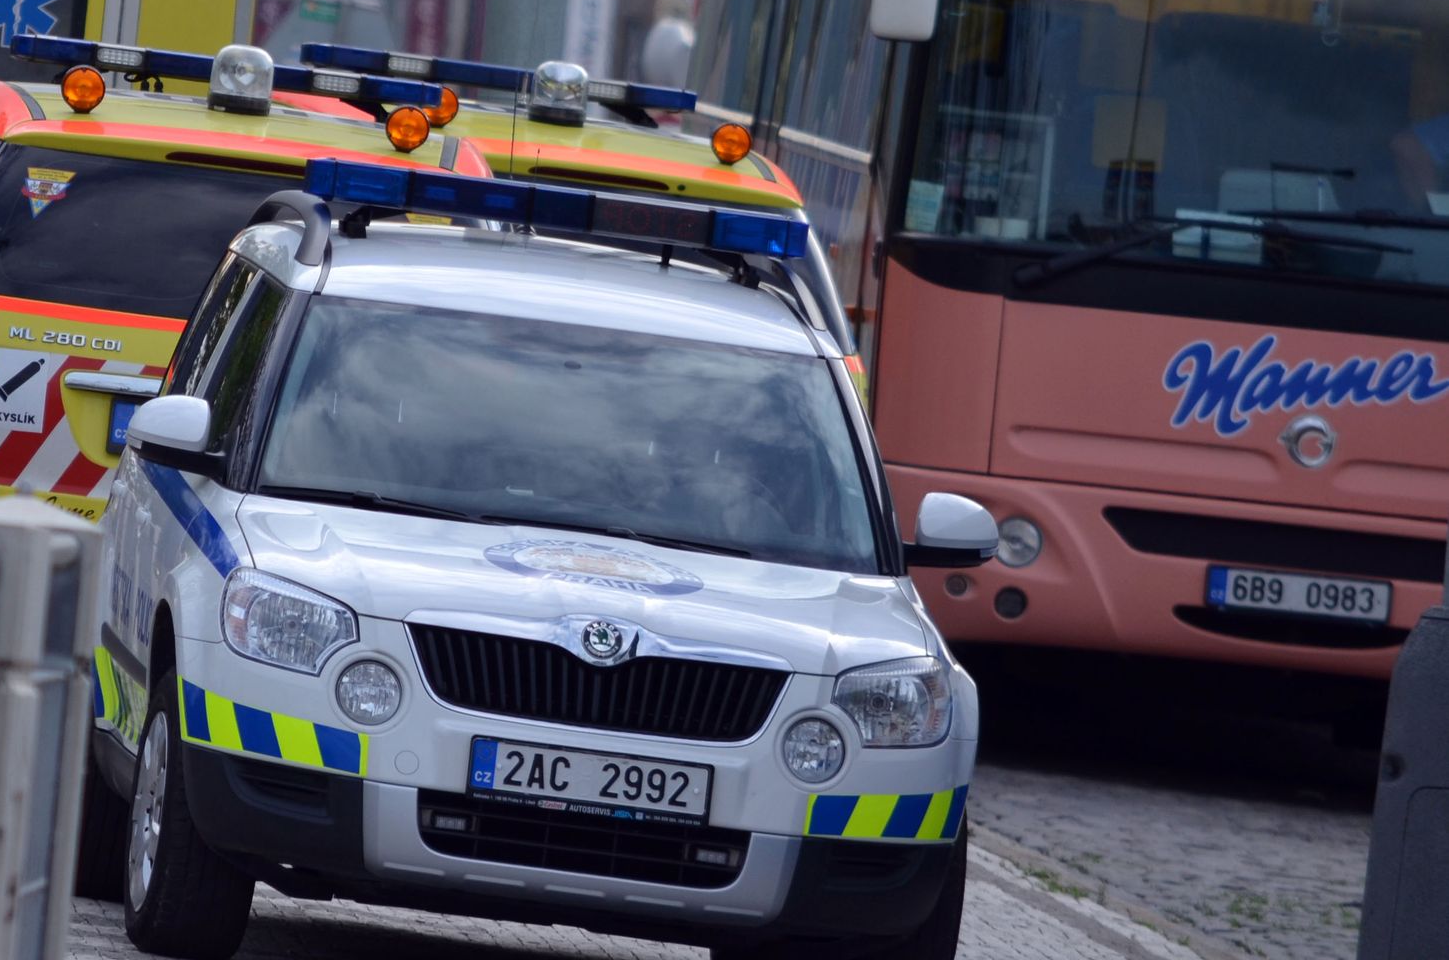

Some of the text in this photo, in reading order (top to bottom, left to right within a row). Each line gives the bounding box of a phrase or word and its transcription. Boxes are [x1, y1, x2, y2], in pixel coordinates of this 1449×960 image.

[9, 326, 122, 352] ML 280 CDI
[1162, 333, 1449, 437] Manner
[1233, 574, 1284, 605] 6B9
[1305, 581, 1375, 614] 0983
[474, 750, 690, 808] CZ 2AC 2992
[568, 804, 611, 817] AUTOSERVIS
